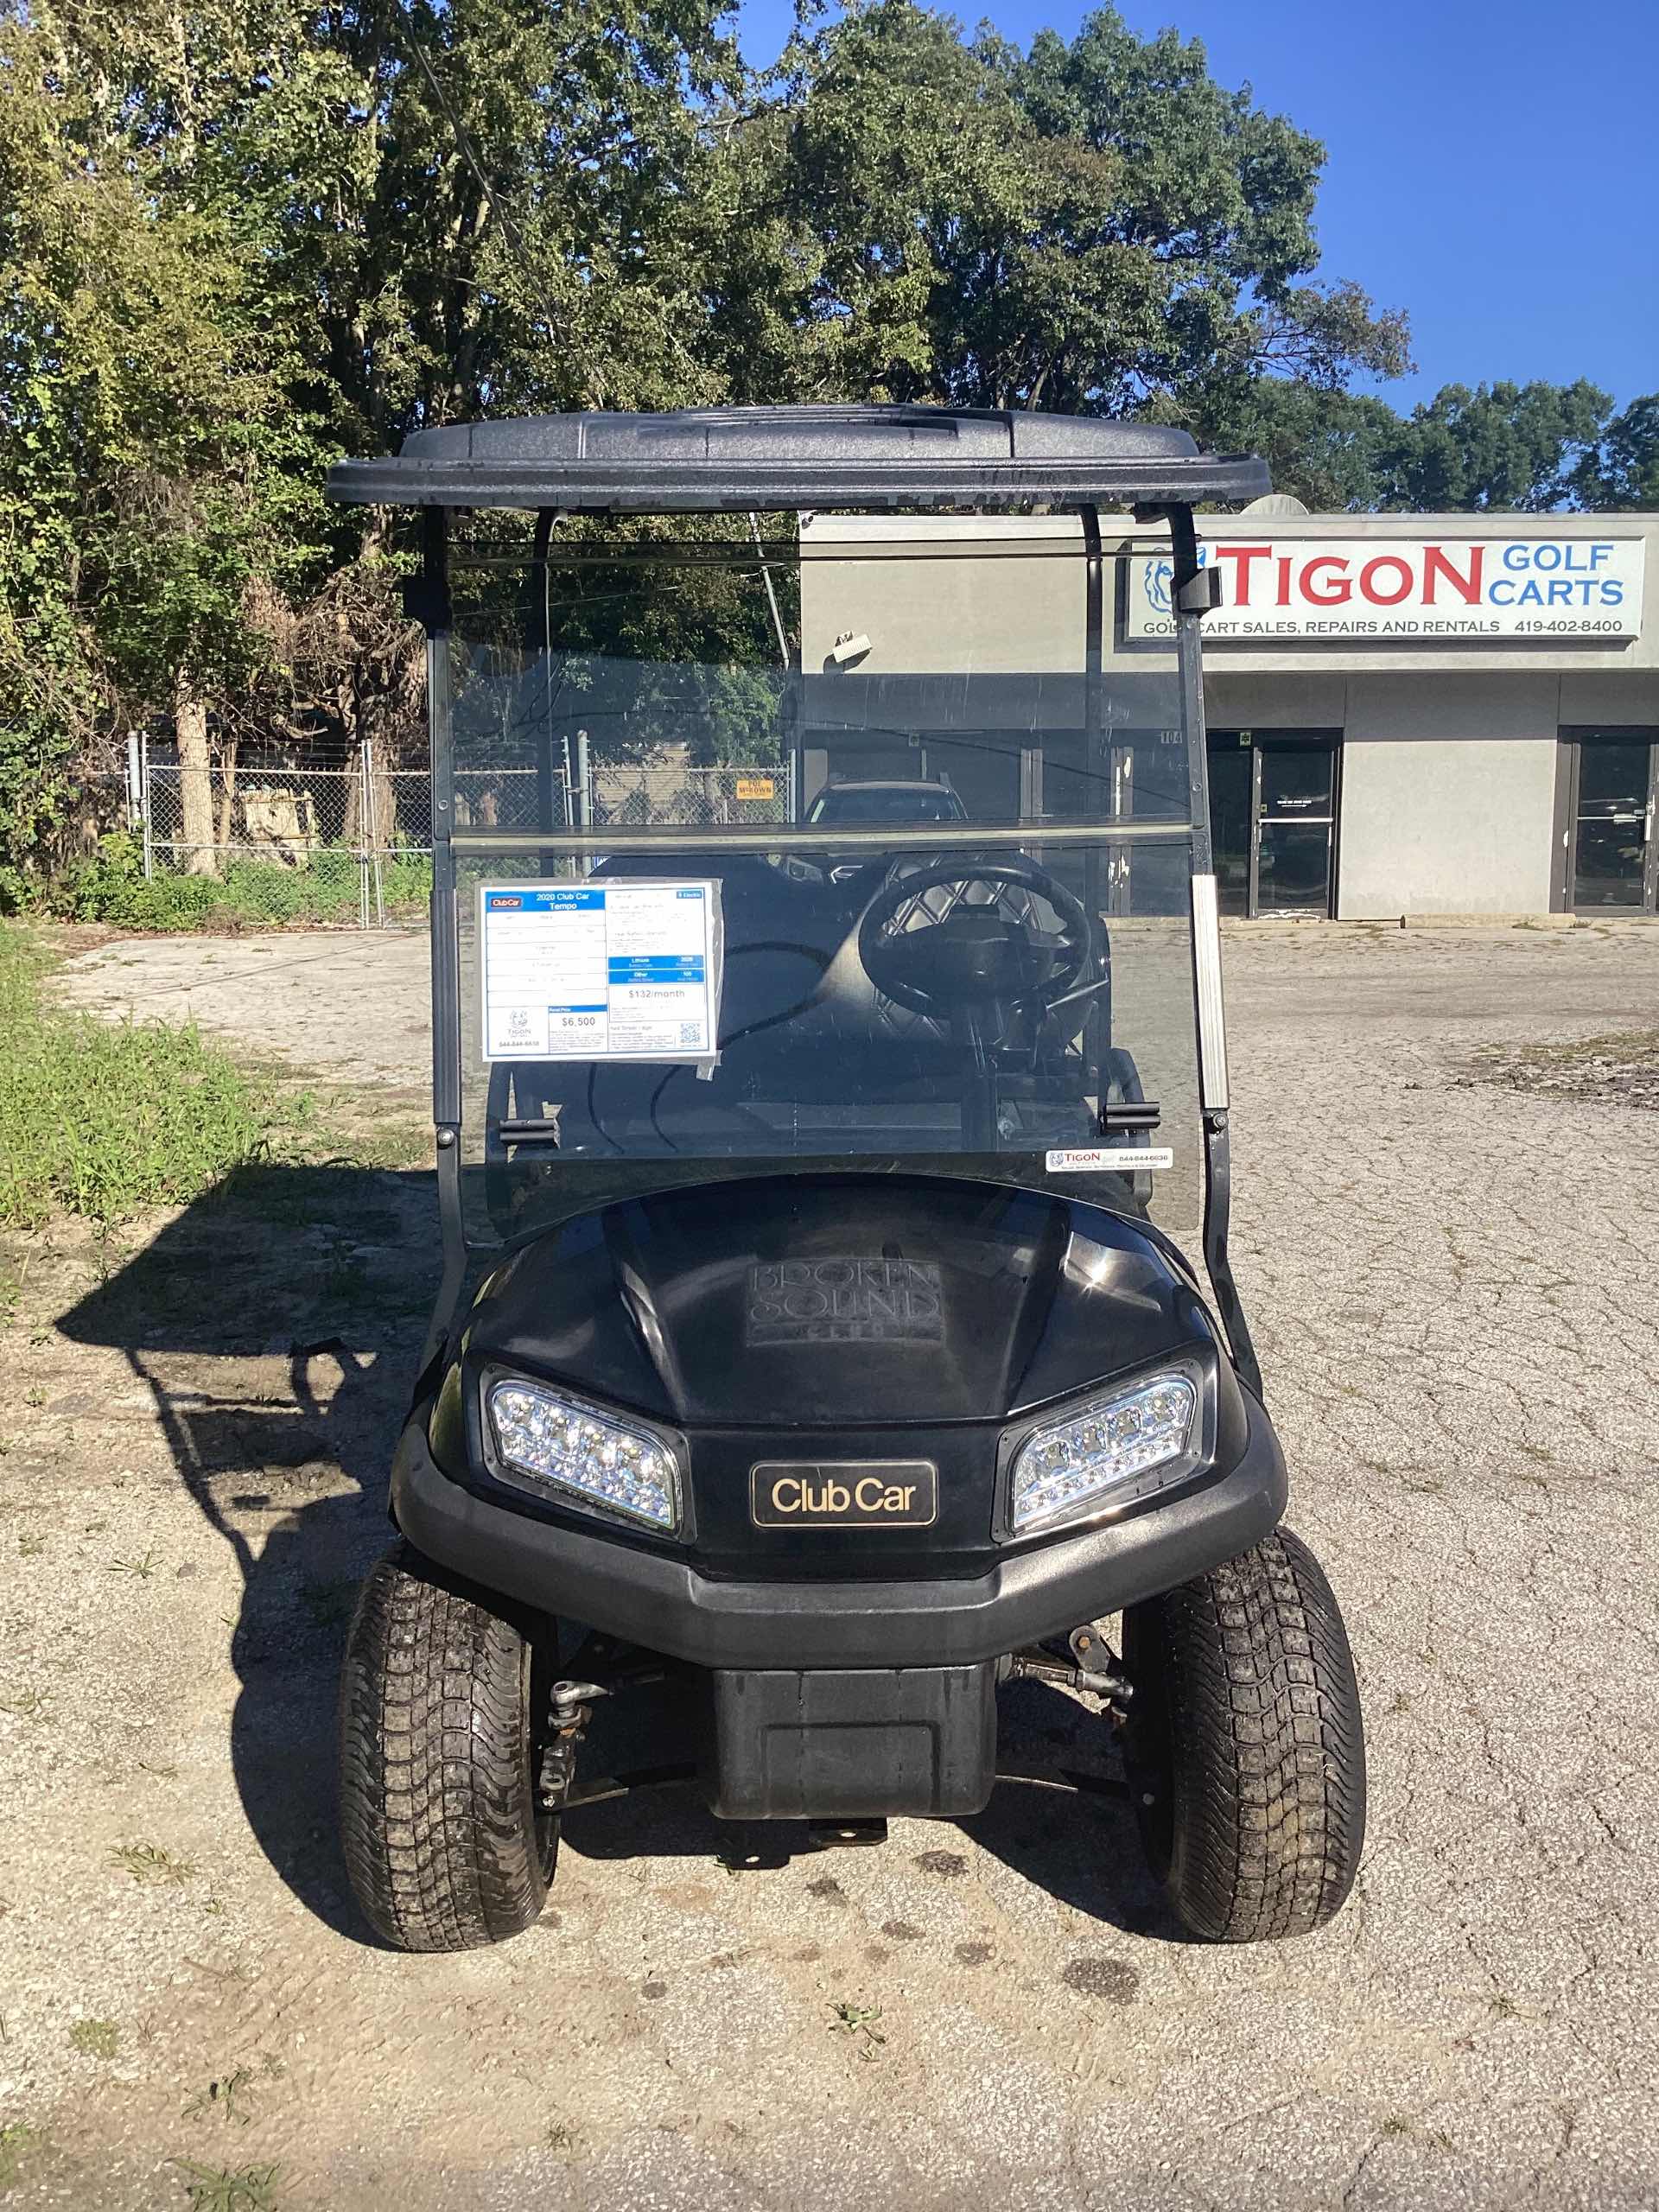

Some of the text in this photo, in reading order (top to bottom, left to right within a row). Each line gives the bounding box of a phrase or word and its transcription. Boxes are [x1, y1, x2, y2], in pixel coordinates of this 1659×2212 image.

[1502, 544, 1614, 571] GOLF
[1215, 544, 1486, 607] TIGON
[1488, 580, 1624, 606] CARTS
[1143, 621, 1180, 634] GOL
[1243, 621, 1301, 634] SALES,
[1306, 621, 1378, 632] REPAIRS
[1382, 621, 1419, 632] AND
[1422, 620, 1500, 632] RENTALS
[1515, 620, 1623, 632] 419-402-8400
[550, 902, 577, 911] Tempo
[628, 989, 685, 999] $132/month
[1064, 1152, 1101, 1161] TIGON
[771, 1477, 917, 1513] Club Car
